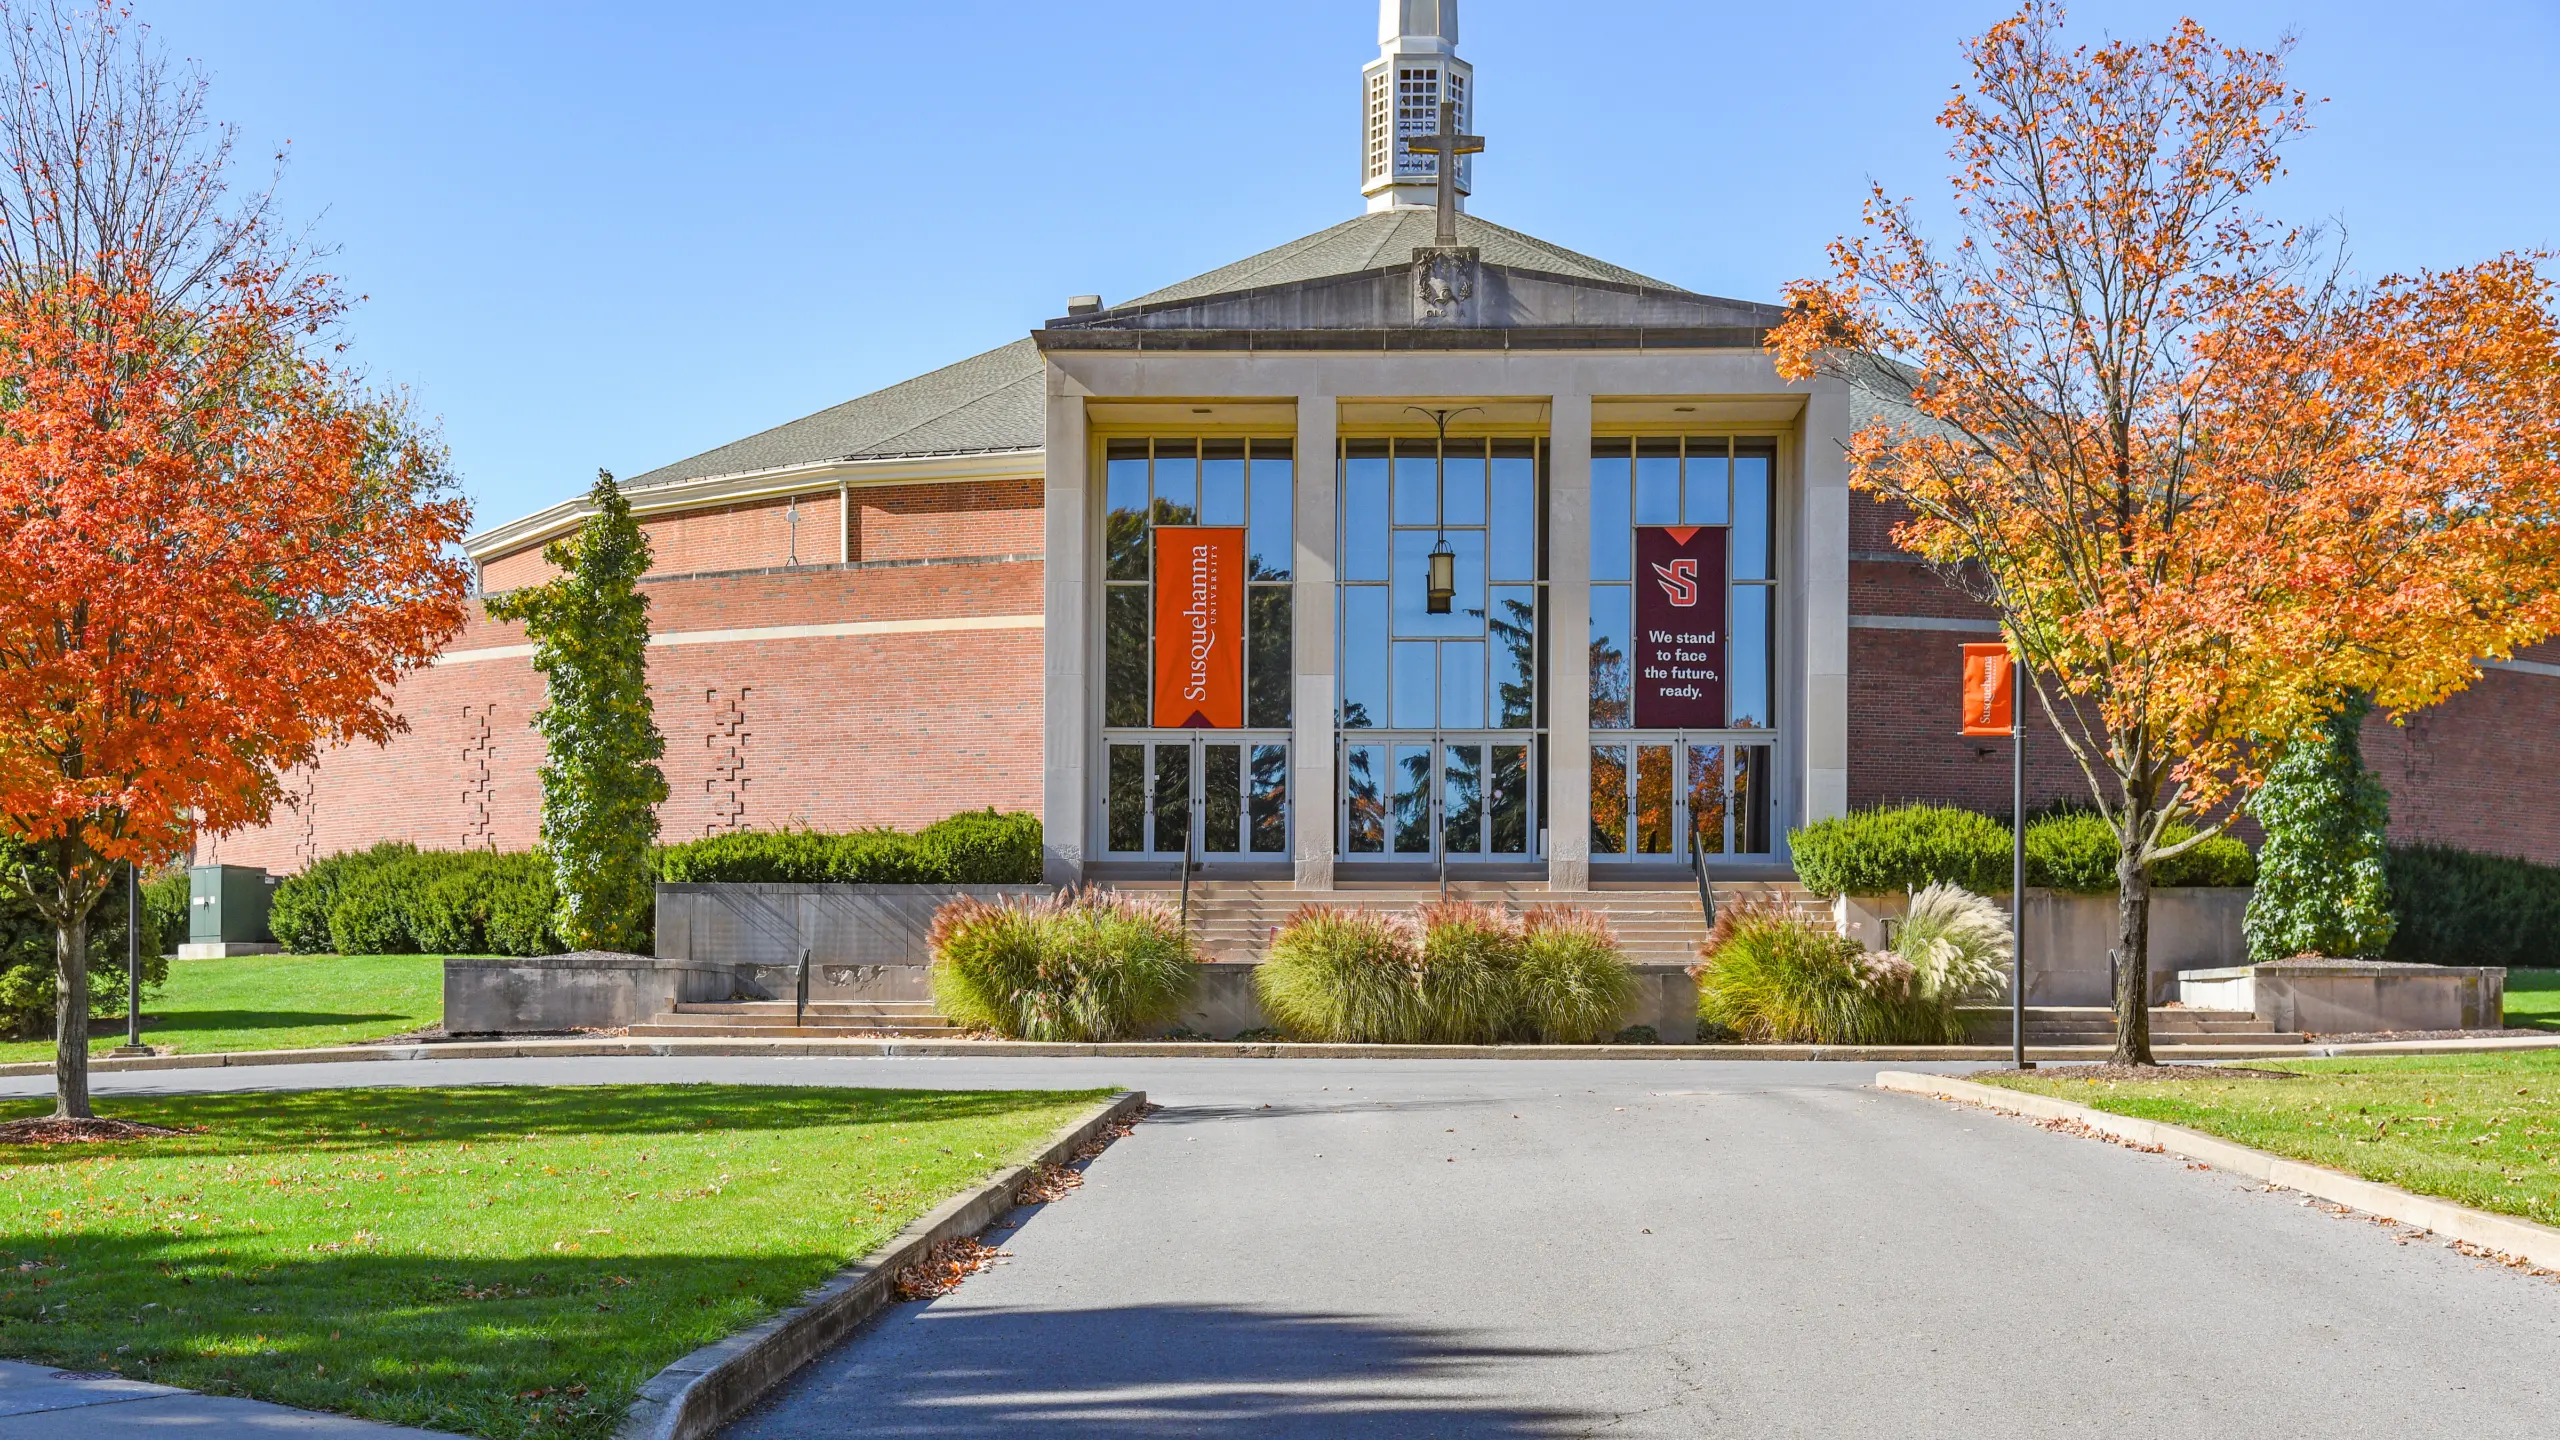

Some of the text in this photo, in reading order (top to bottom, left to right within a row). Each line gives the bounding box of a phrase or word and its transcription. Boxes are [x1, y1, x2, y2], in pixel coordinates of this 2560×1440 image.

[1210, 544, 1218, 625] UNIVERSITY
[1183, 544, 1215, 702] Susquehanna
[1649, 630, 1715, 644] We stand
[1656, 648, 1707, 662] to face
[1644, 666, 1719, 682] the future,
[1659, 685, 1702, 700] ready.
